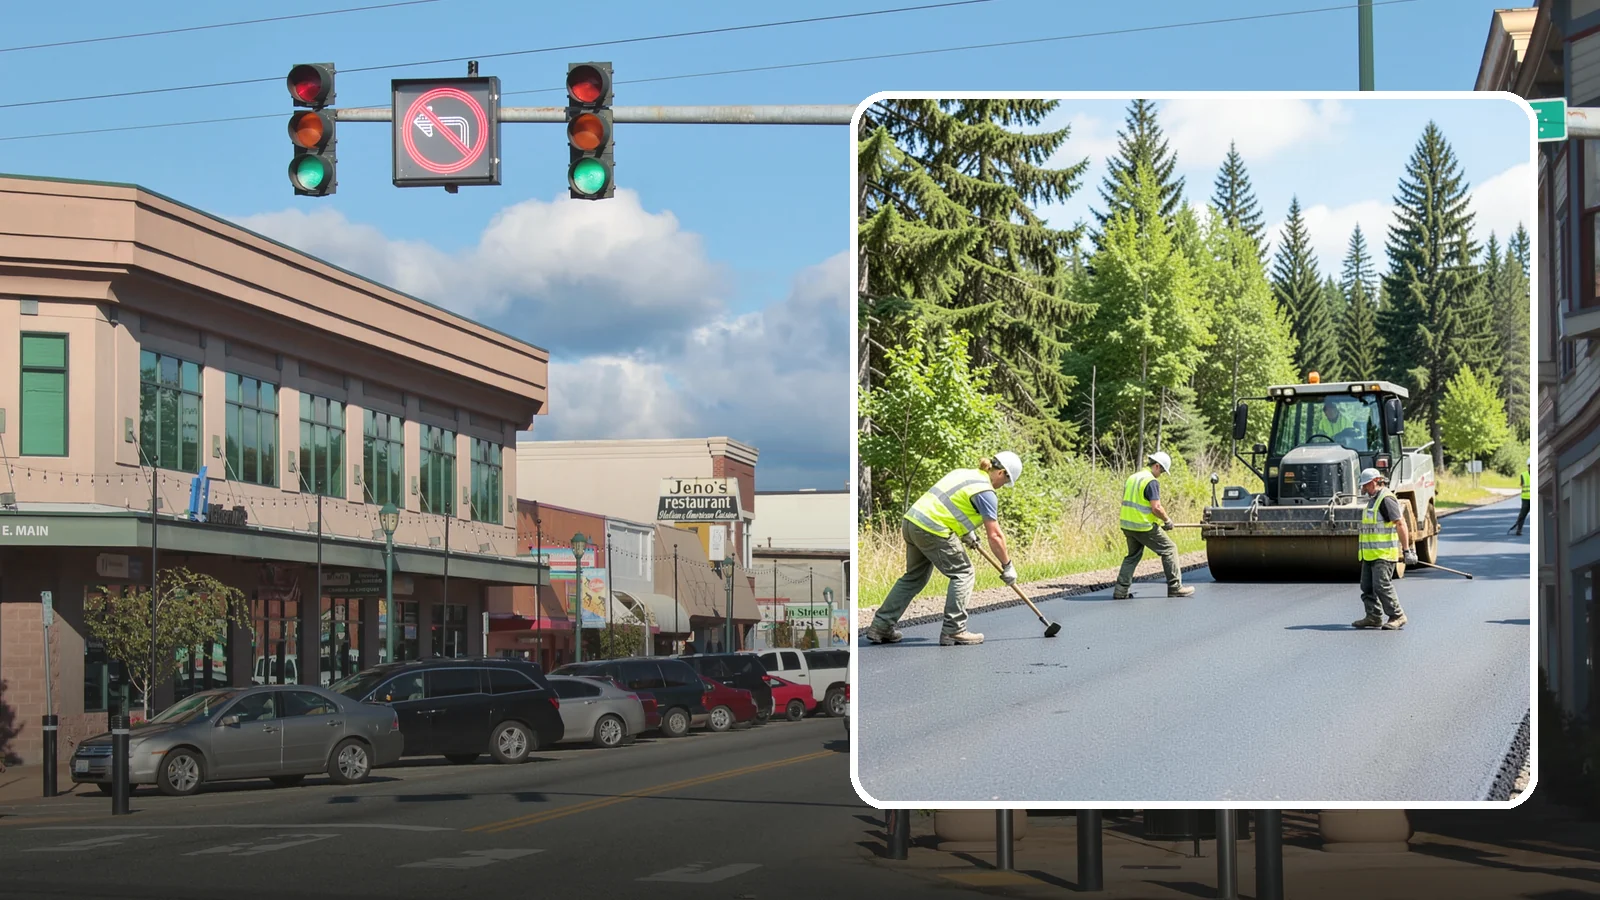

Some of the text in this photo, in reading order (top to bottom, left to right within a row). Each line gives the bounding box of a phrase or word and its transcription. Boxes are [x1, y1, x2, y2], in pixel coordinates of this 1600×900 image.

[669, 480, 728, 495] Jeno's
[665, 496, 731, 509] restaurant
[658, 510, 682, 520] Italian
[686, 510, 715, 519] American
[715, 510, 738, 519] Cuisine
[2, 525, 49, 536] E. MAIN
[797, 607, 829, 617] Street
